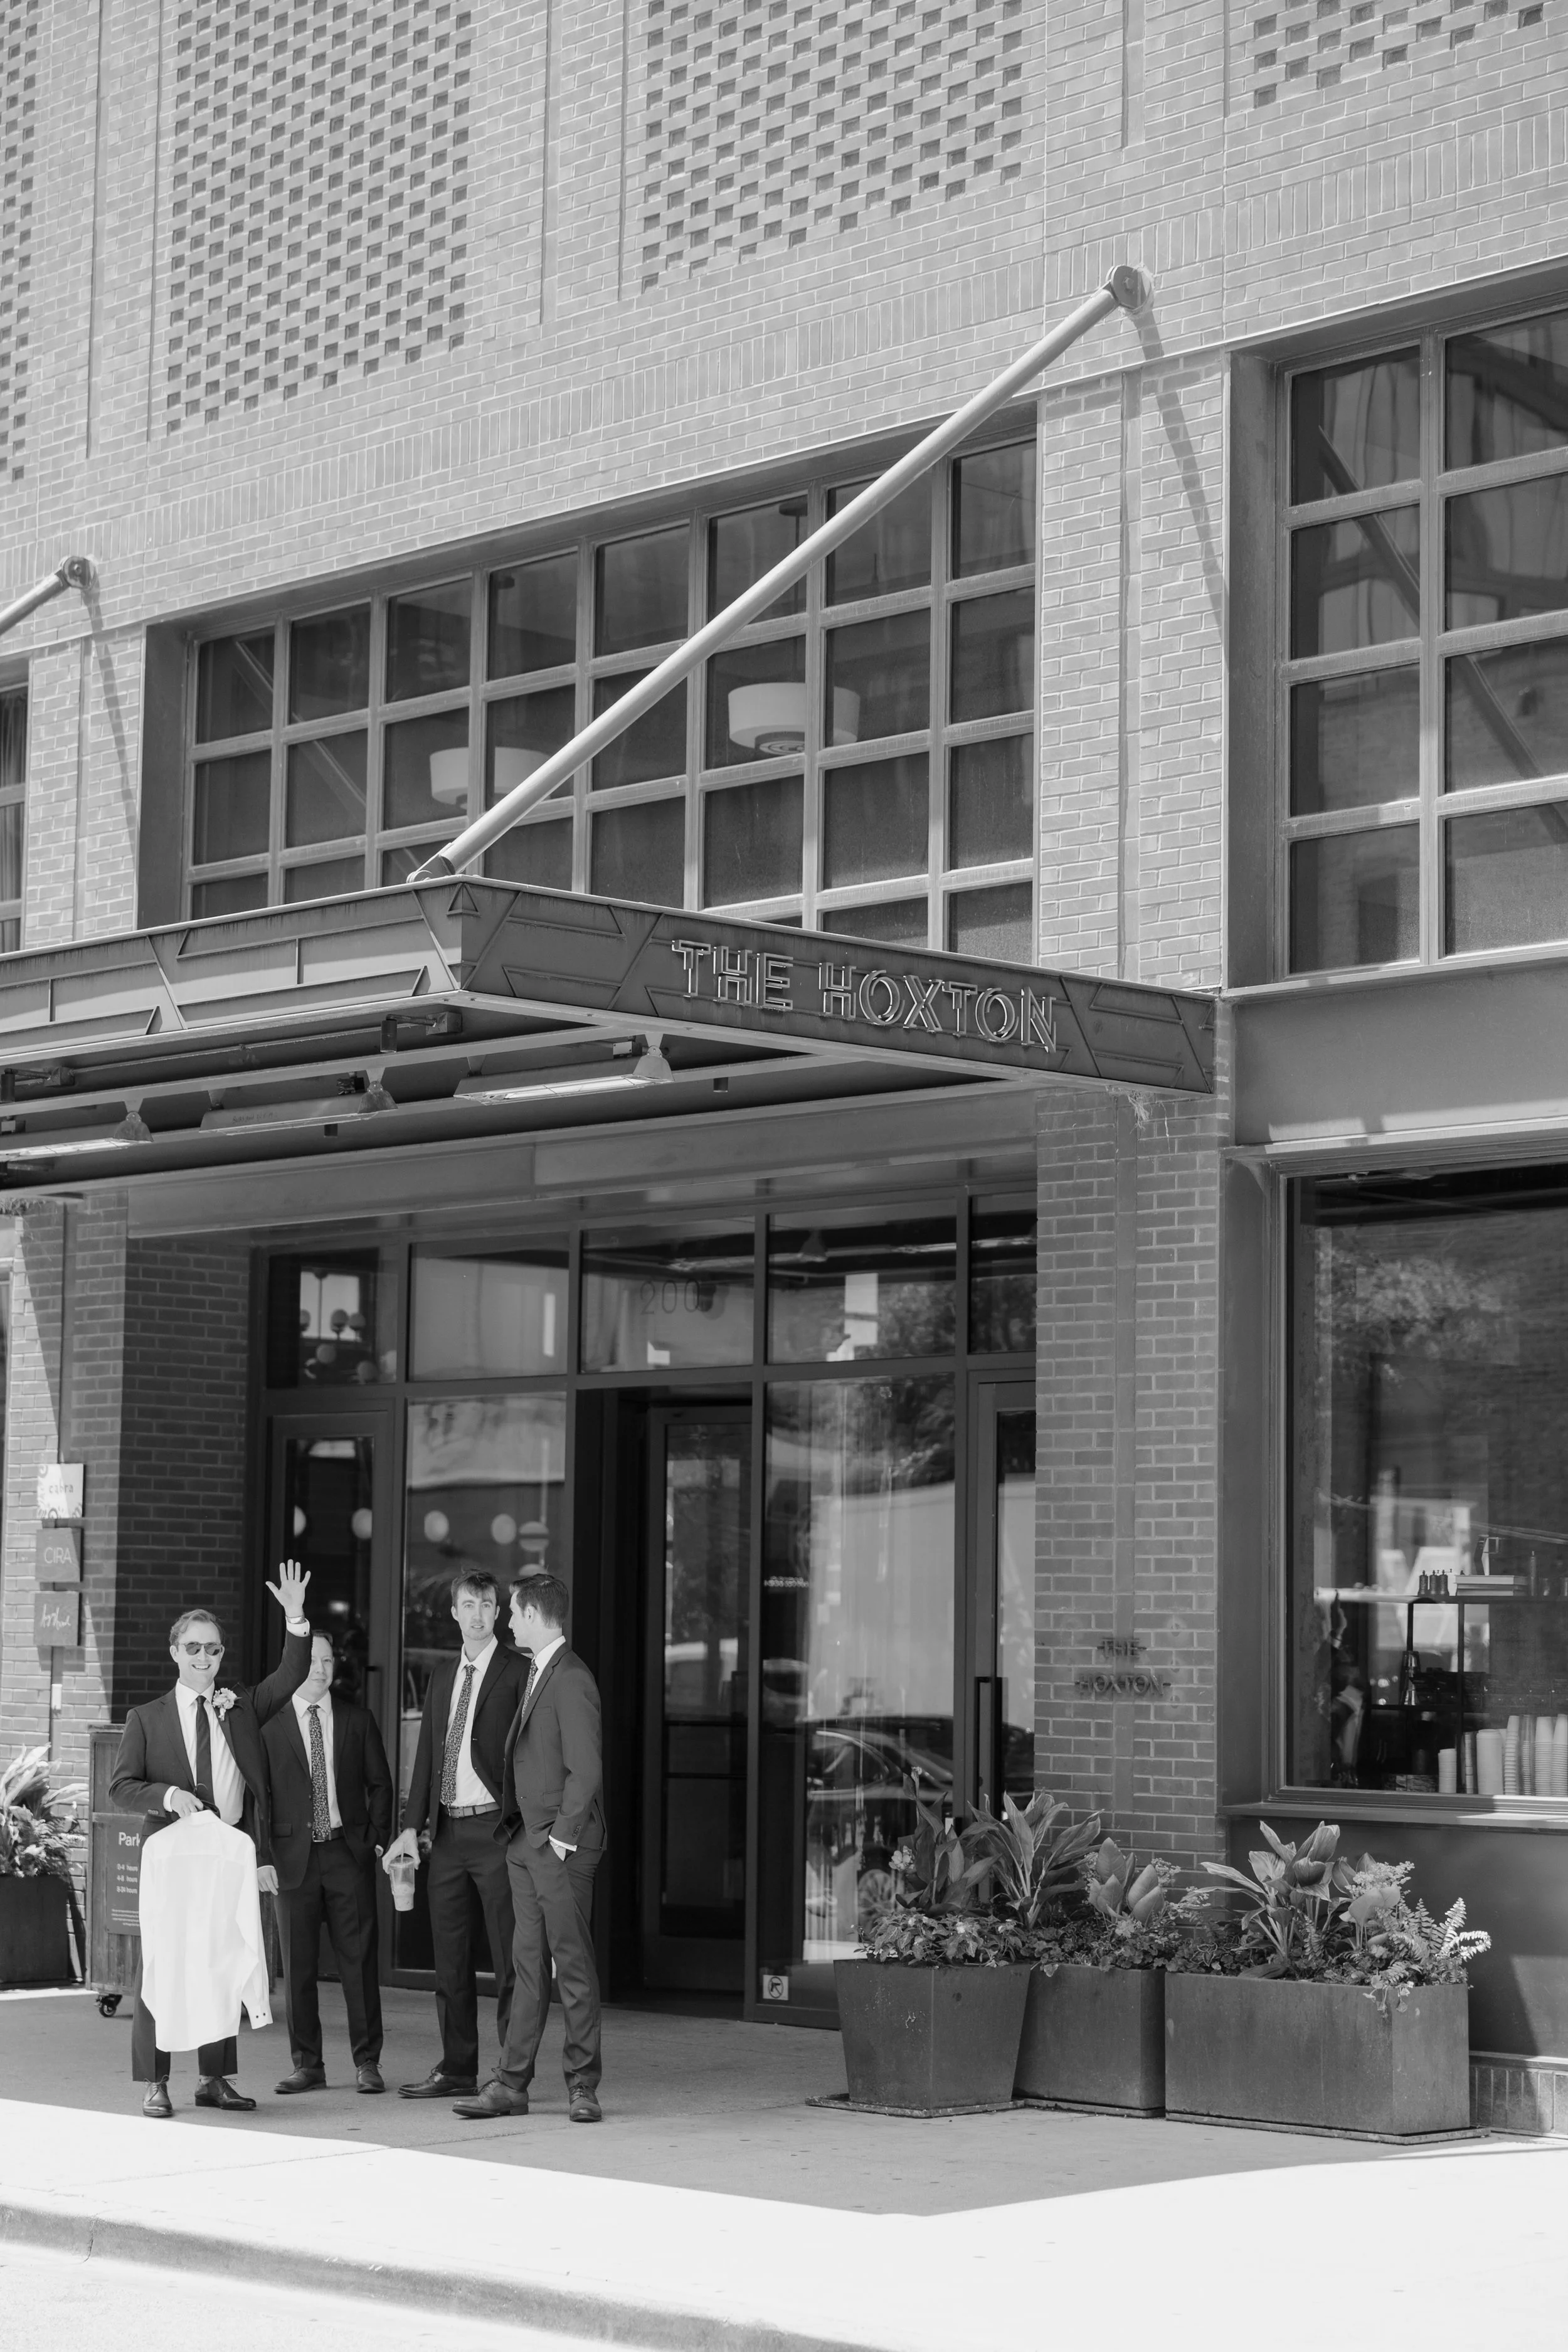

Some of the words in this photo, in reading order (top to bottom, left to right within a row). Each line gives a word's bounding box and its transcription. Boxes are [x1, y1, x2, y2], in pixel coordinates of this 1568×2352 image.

[671, 940, 793, 1010] THE
[818, 960, 1057, 1053] HOXTON
[641, 1279, 699, 1315] 200
[49, 1479, 73, 1495] cabra
[44, 1547, 72, 1564] CIRA
[1102, 1638, 1140, 1659] THE
[1077, 1673, 1163, 1696] HOXTON
